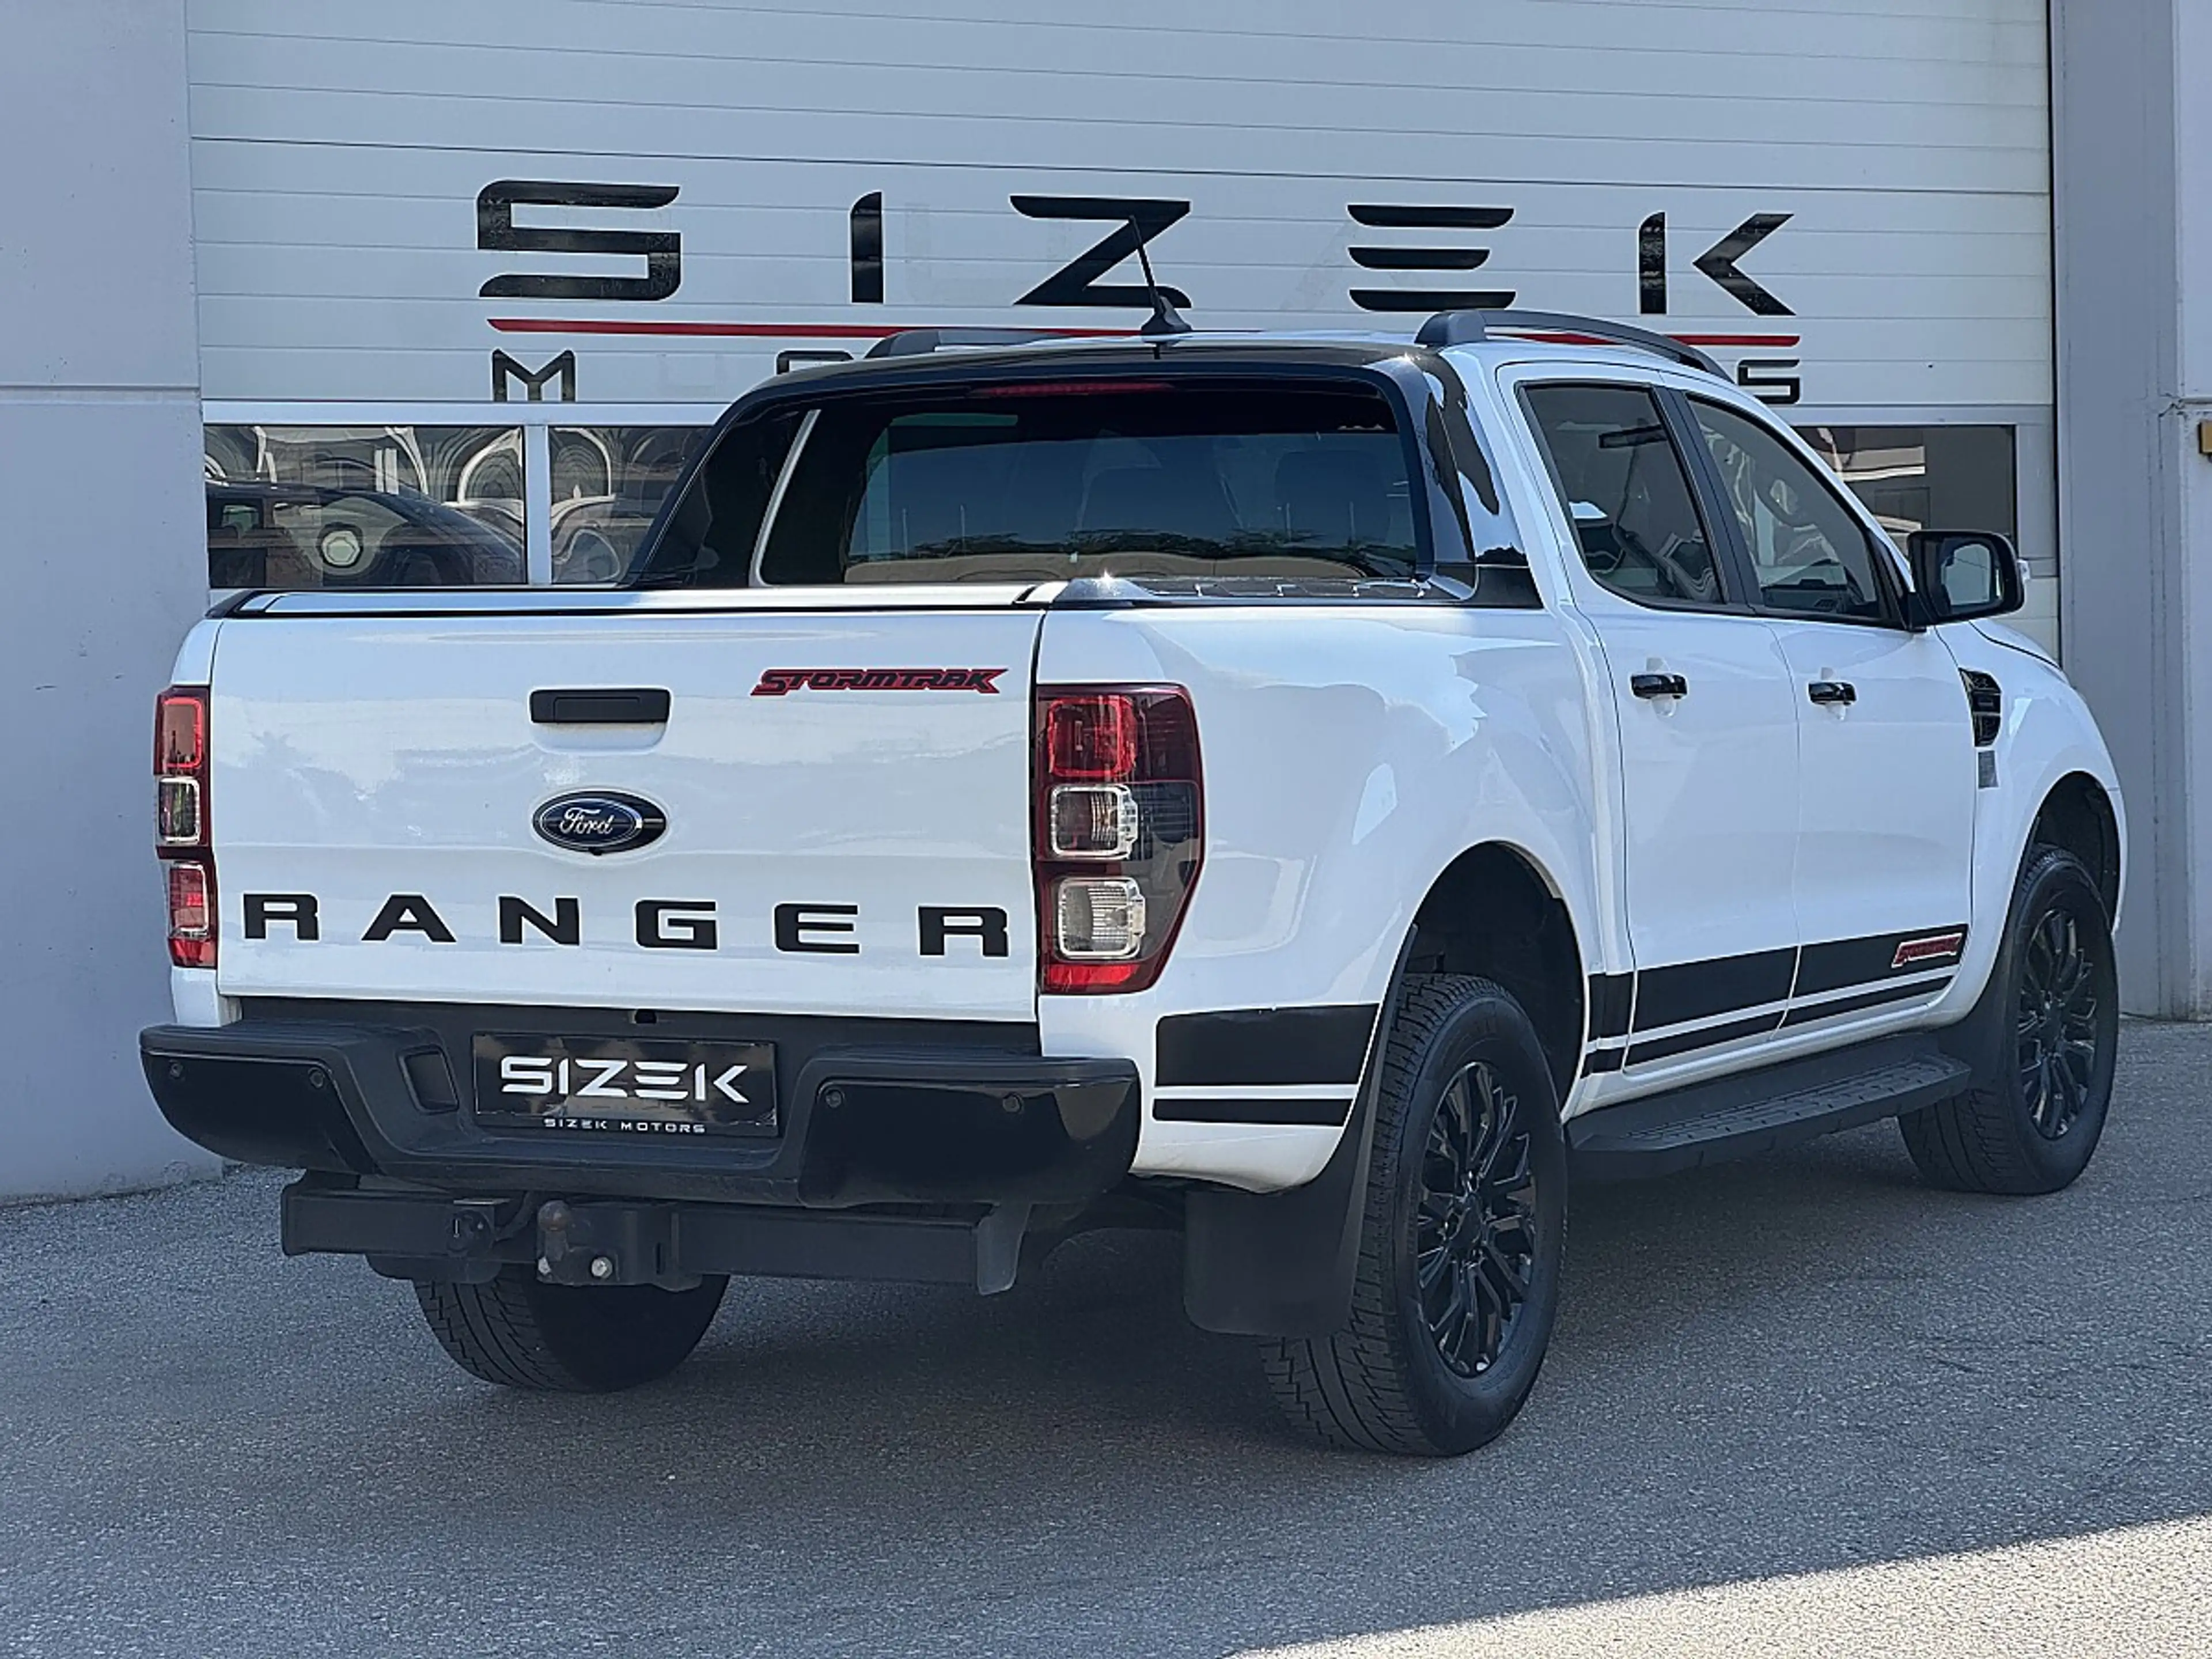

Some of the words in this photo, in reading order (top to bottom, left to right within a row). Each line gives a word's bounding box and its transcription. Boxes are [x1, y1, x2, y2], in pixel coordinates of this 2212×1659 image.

[478, 180, 1796, 315] SIZEK
[751, 668, 1008, 696] STORMTRAK
[559, 808, 615, 834] Ford
[243, 893, 1009, 957] RANGER
[501, 1055, 749, 1103] SIZEK
[544, 1118, 608, 1130] SIZEK
[620, 1121, 706, 1134] MOTORS
